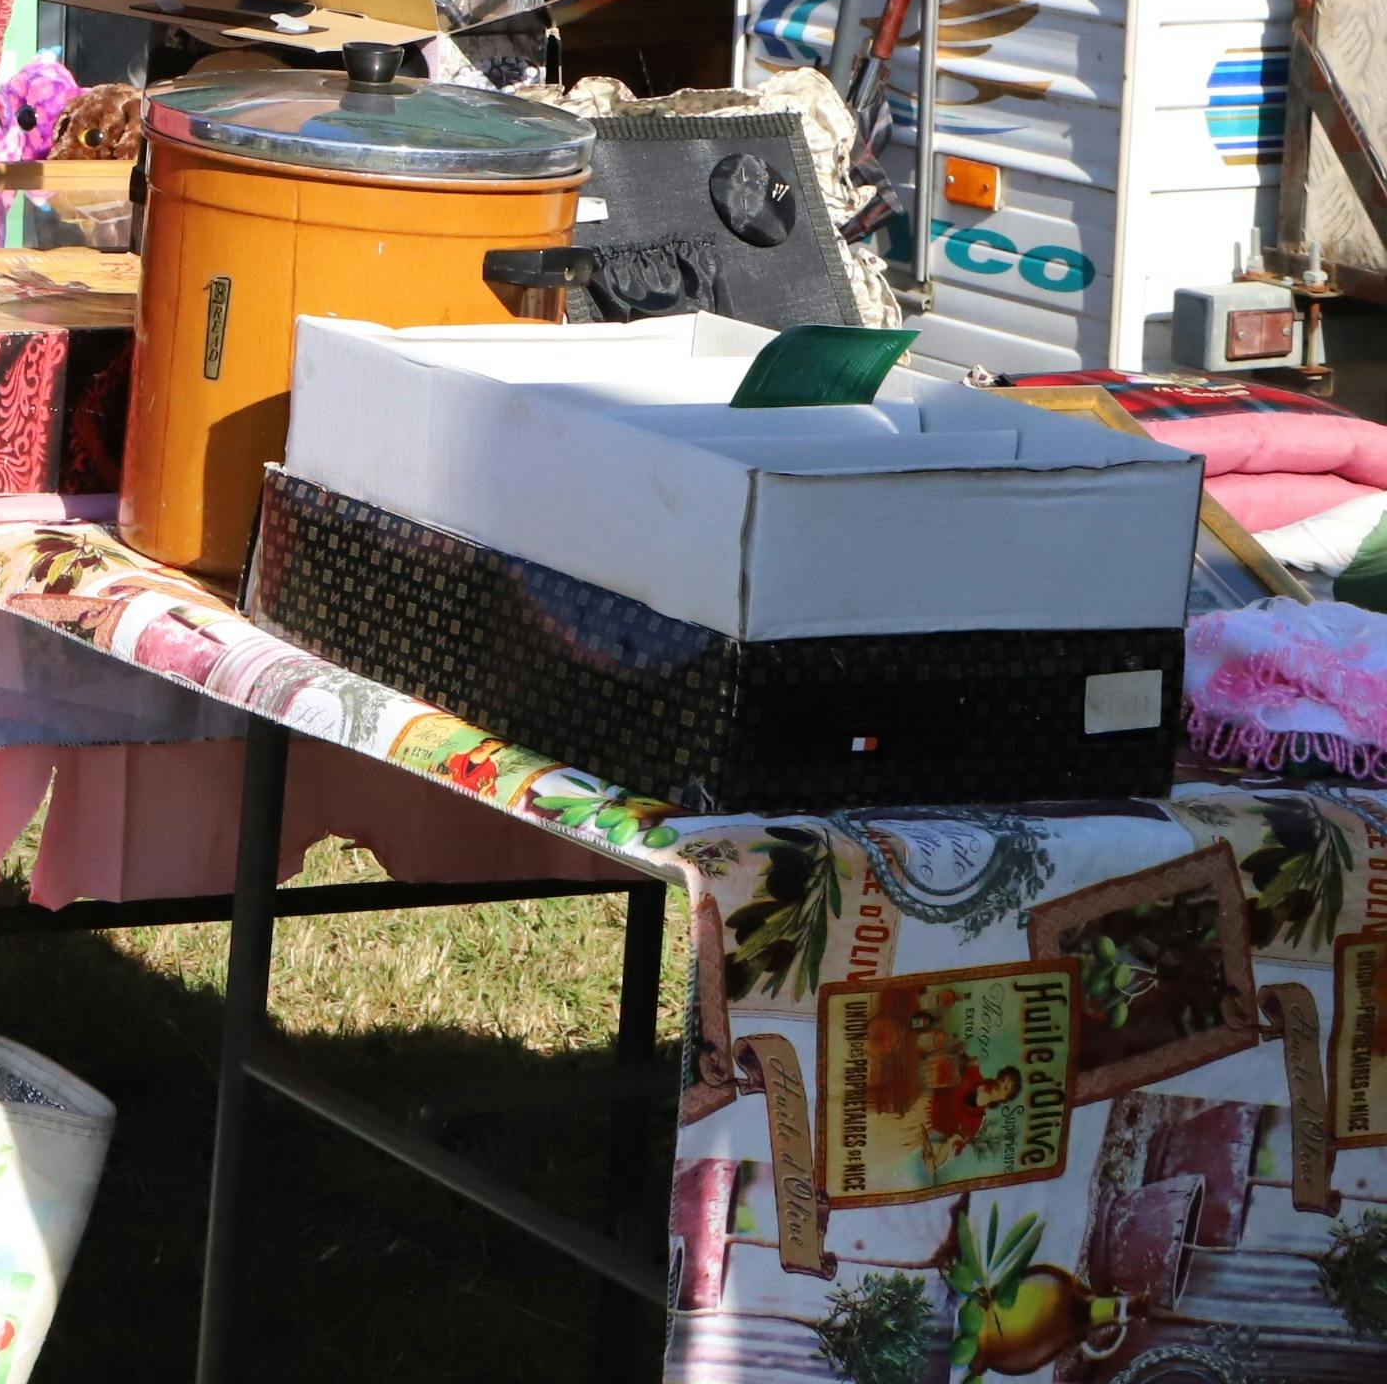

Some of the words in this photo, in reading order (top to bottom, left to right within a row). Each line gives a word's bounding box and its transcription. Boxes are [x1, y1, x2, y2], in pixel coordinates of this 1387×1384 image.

[208, 280, 227, 362] BREAD
[847, 904, 891, 983] D'OLIV
[843, 1000, 869, 1042] UNION
[849, 1041, 865, 1059] DES
[962, 1007, 975, 1041] EXTRA
[1013, 980, 1068, 1066] Huile
[768, 1055, 803, 1148] Huile
[843, 1058, 868, 1149] PROPRIETAIRES
[1020, 1071, 1067, 1167] d'Olive
[1347, 1103, 1370, 1134] NICE
[843, 1161, 867, 1193] NICE
[851, 1149, 863, 1163] DE
[780, 1152, 814, 1248] d'Olive
